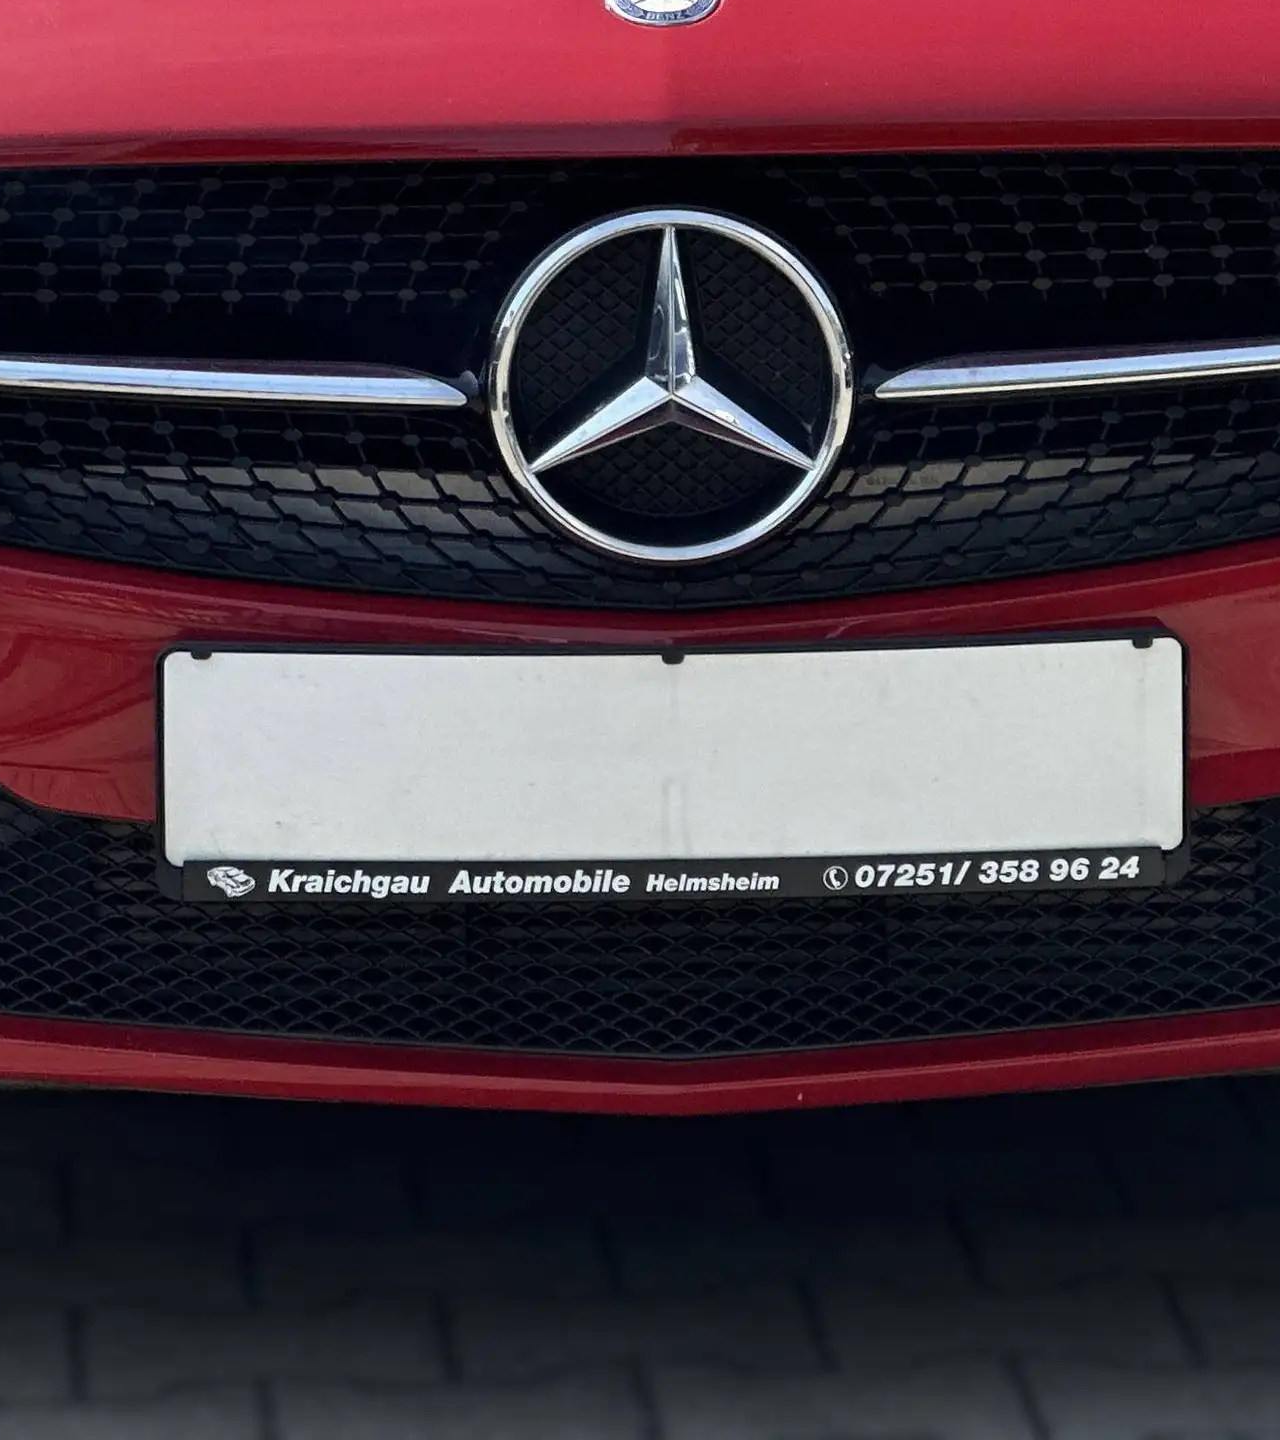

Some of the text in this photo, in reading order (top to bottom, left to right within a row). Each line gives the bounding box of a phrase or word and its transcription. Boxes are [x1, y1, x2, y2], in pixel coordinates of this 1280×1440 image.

[268, 856, 1139, 898] Kraichgau Automobile Helmsheim 07251/ 358 96 24
